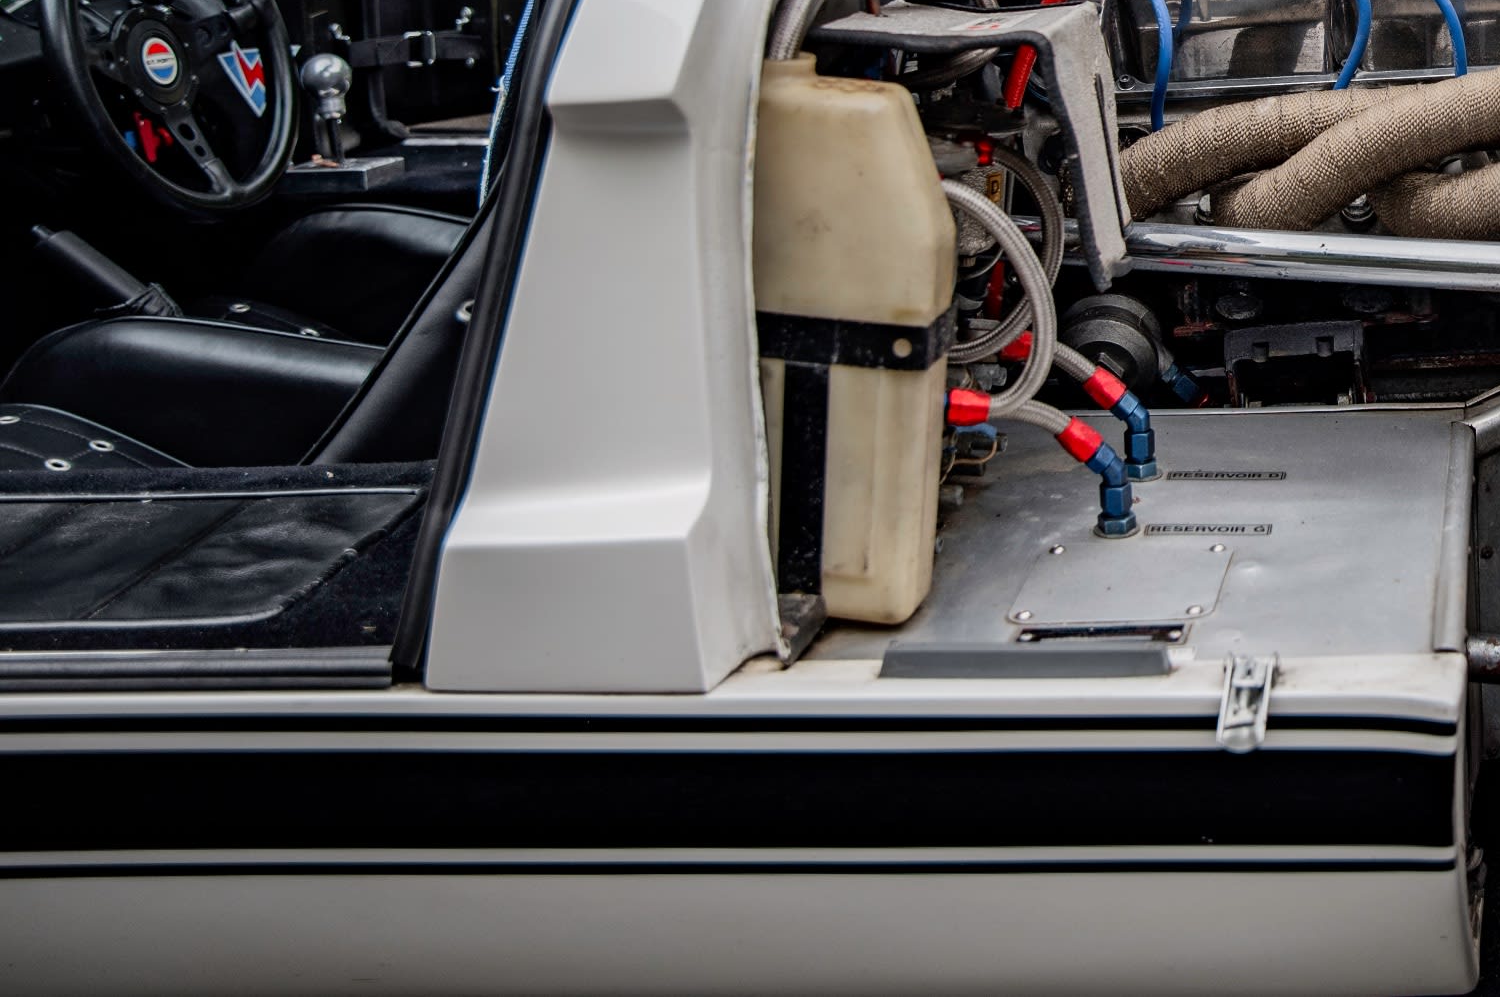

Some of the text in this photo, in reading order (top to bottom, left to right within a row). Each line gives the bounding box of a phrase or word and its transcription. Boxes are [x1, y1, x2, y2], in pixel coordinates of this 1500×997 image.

[1172, 471, 1280, 479] RESERVOIR D
[1150, 524, 1246, 534] RESERVOIR
